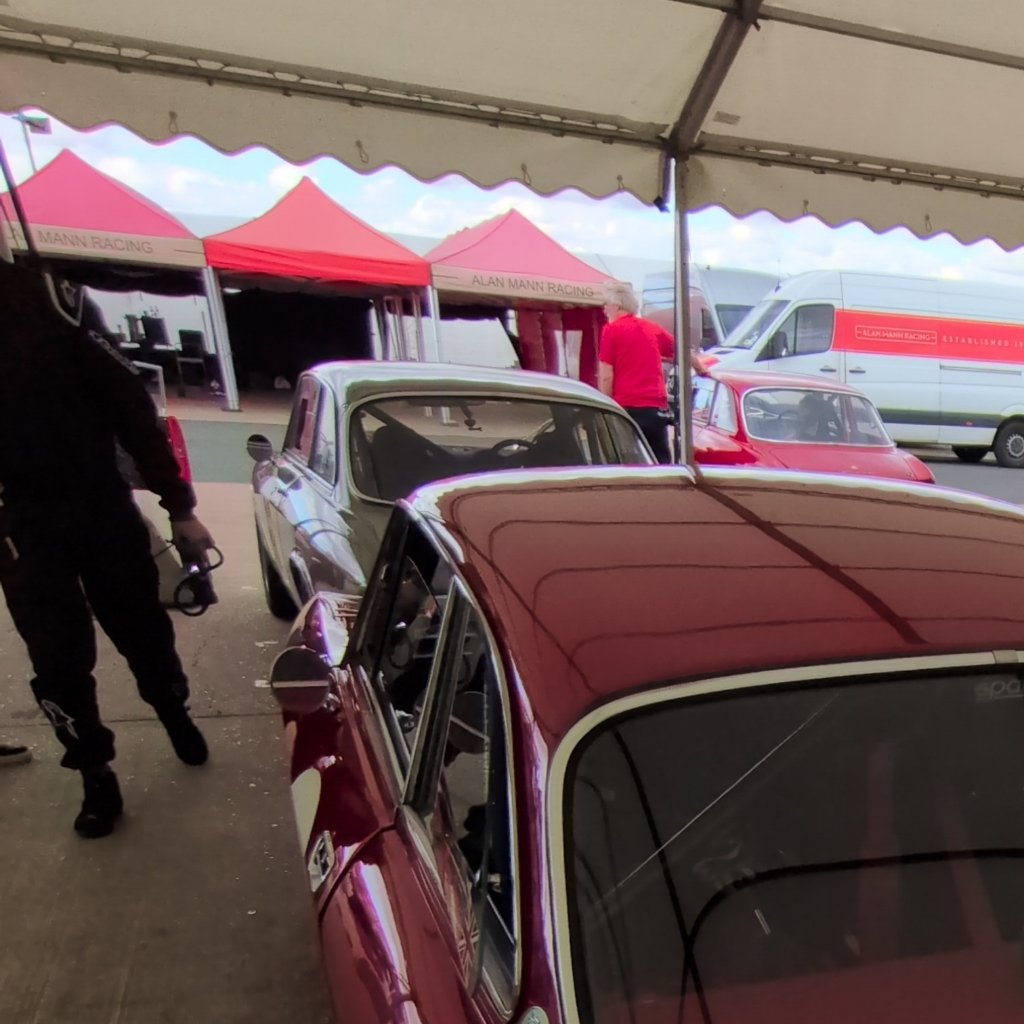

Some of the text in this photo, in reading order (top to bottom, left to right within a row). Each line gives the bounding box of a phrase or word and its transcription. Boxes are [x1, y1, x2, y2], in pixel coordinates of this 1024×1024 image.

[38, 230, 87, 247] MANN
[91, 236, 153, 254] RACING
[472, 275, 594, 297] ALAN MANN RACING
[862, 329, 931, 341] ALAN MANN RACING
[942, 335, 1009, 347] ESTABLISHED
